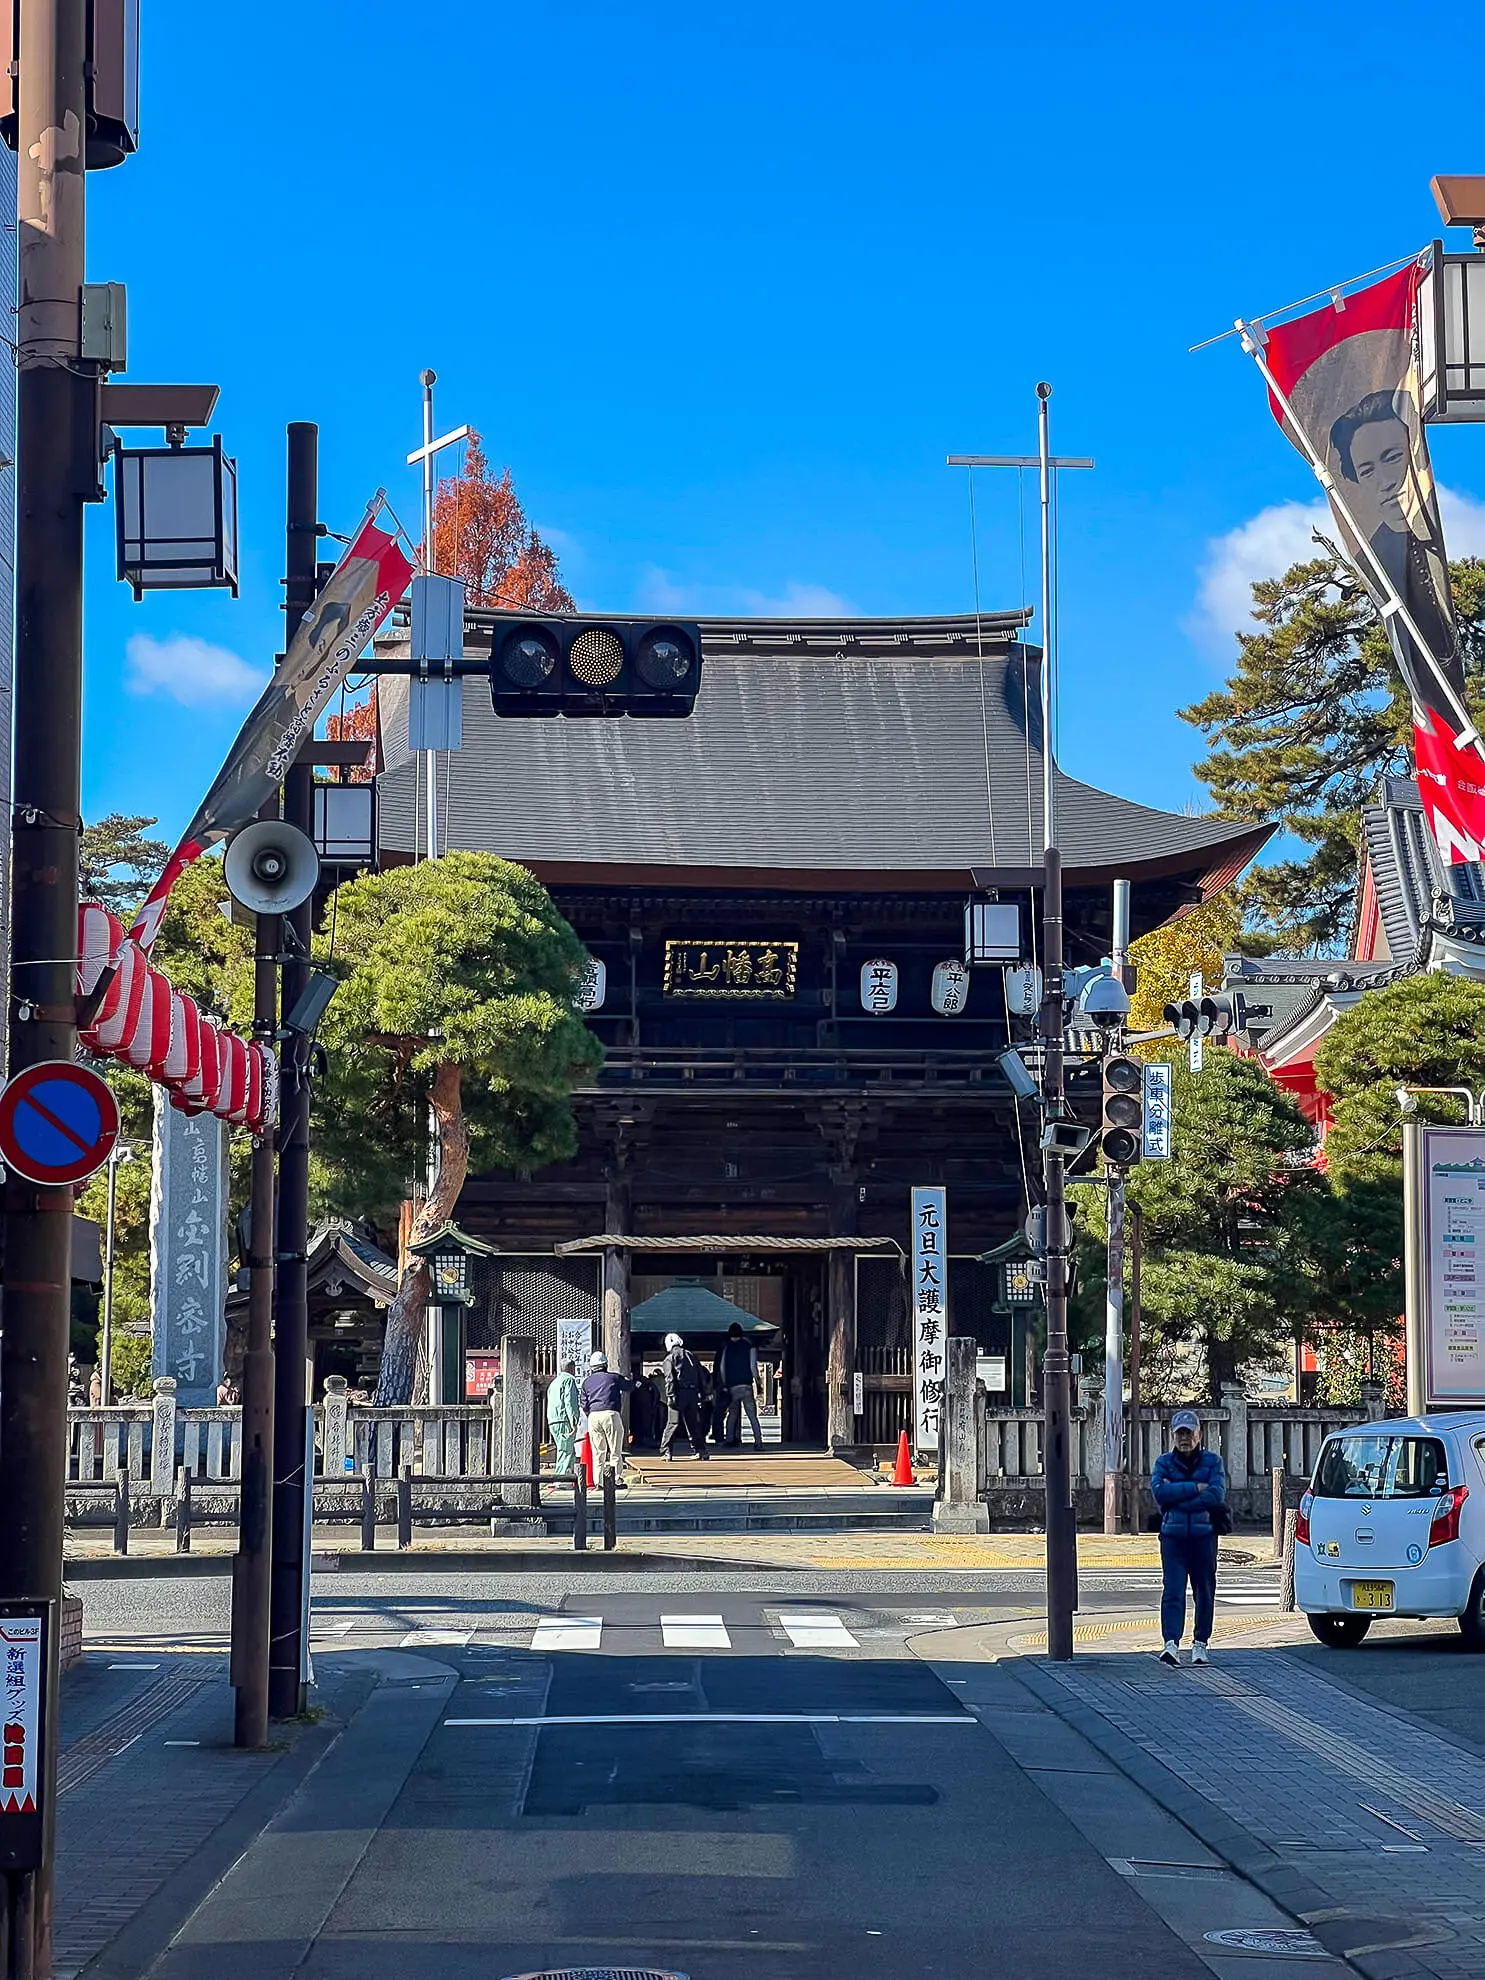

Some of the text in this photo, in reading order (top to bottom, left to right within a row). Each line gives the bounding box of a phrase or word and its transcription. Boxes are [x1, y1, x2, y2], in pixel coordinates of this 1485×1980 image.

[687, 948, 783, 985] 高幡山
[1149, 1070, 1165, 1152] 歩車分離式
[916, 1203, 943, 1434] 元旦大護摩御修行
[8, 1627, 39, 1636] このビル3F
[6, 1646, 28, 1723] 新選組グッズ
